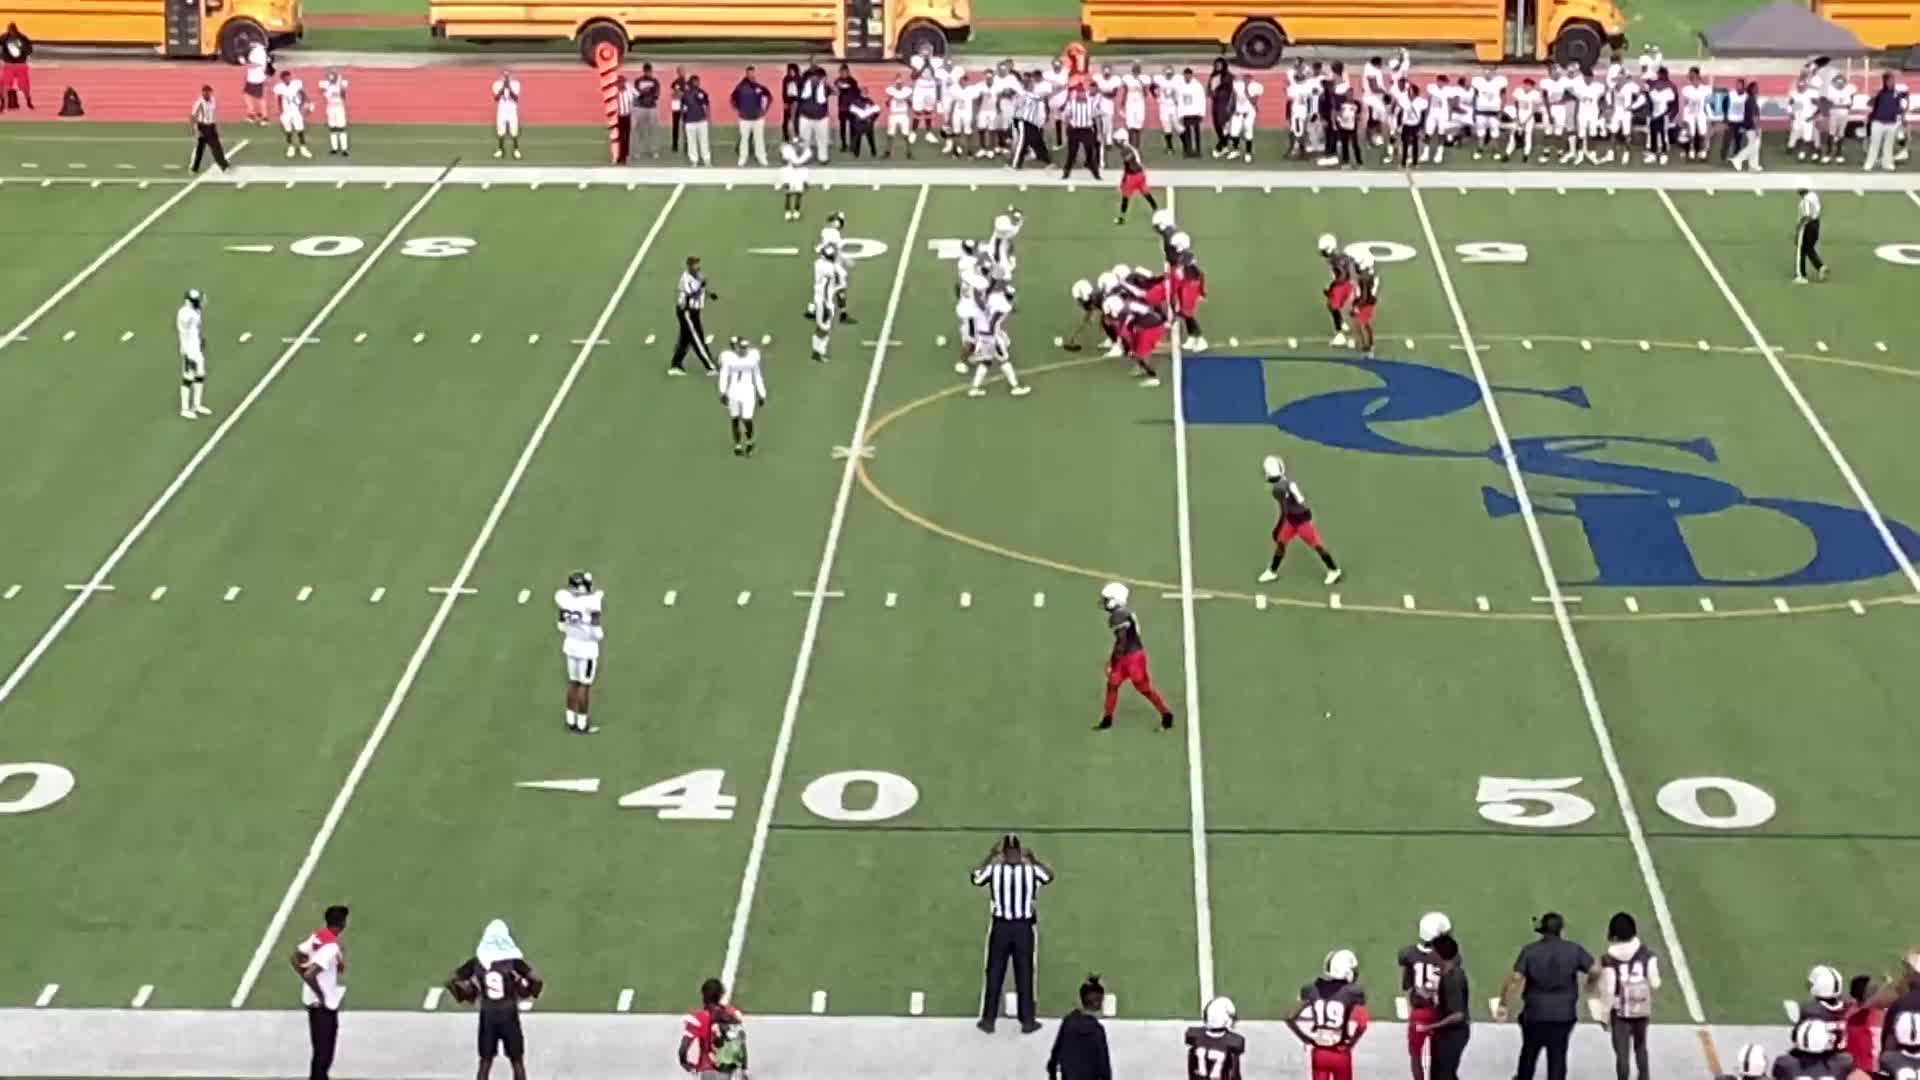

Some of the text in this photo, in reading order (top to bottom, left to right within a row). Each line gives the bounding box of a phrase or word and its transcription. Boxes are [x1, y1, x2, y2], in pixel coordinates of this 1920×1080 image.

[618, 769, 919, 821] 40
[1476, 776, 1776, 828] 50
[486, 971, 504, 999] 9
[1414, 962, 1440, 991] 15
[1314, 1000, 1345, 1027] 19
[1194, 1047, 1226, 1080] 17
